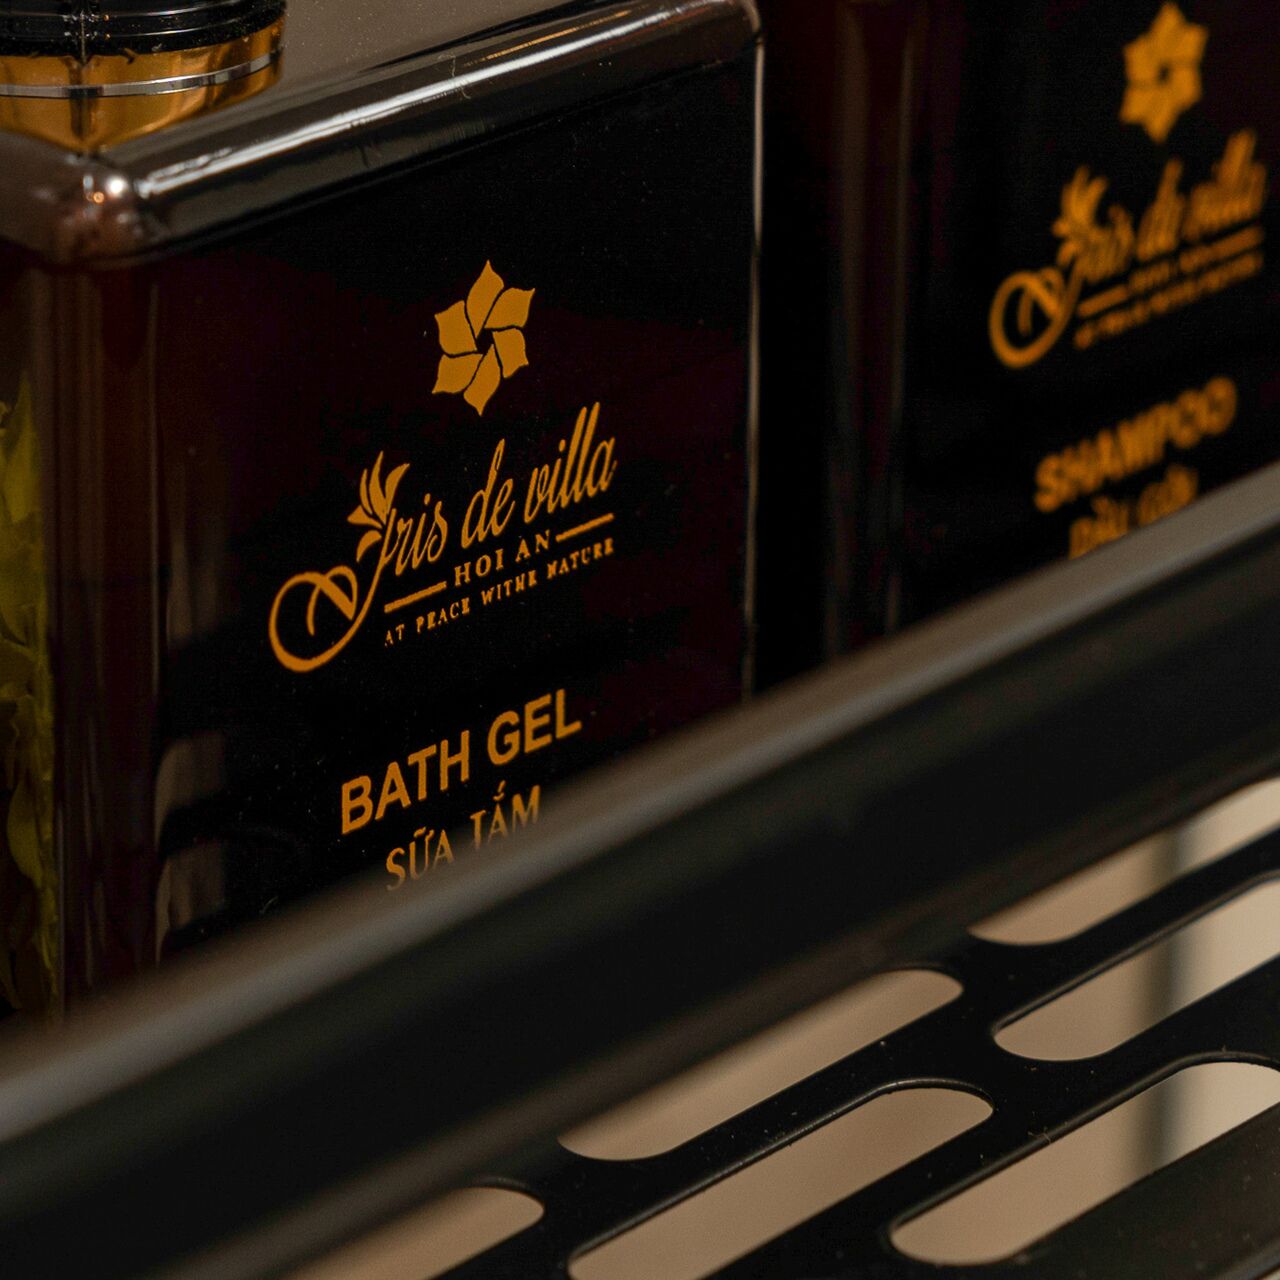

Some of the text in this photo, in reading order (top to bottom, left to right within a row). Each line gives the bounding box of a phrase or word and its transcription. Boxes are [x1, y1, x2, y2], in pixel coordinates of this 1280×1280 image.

[460, 438, 516, 550] de
[523, 401, 618, 525] villa
[1034, 377, 1237, 513] SHAMPOO
[384, 622, 406, 647] AT
[415, 596, 472, 634] PEACE
[546, 538, 616, 580] NATURE
[453, 529, 552, 587] HOI AN
[340, 688, 583, 836] BATH GEL
